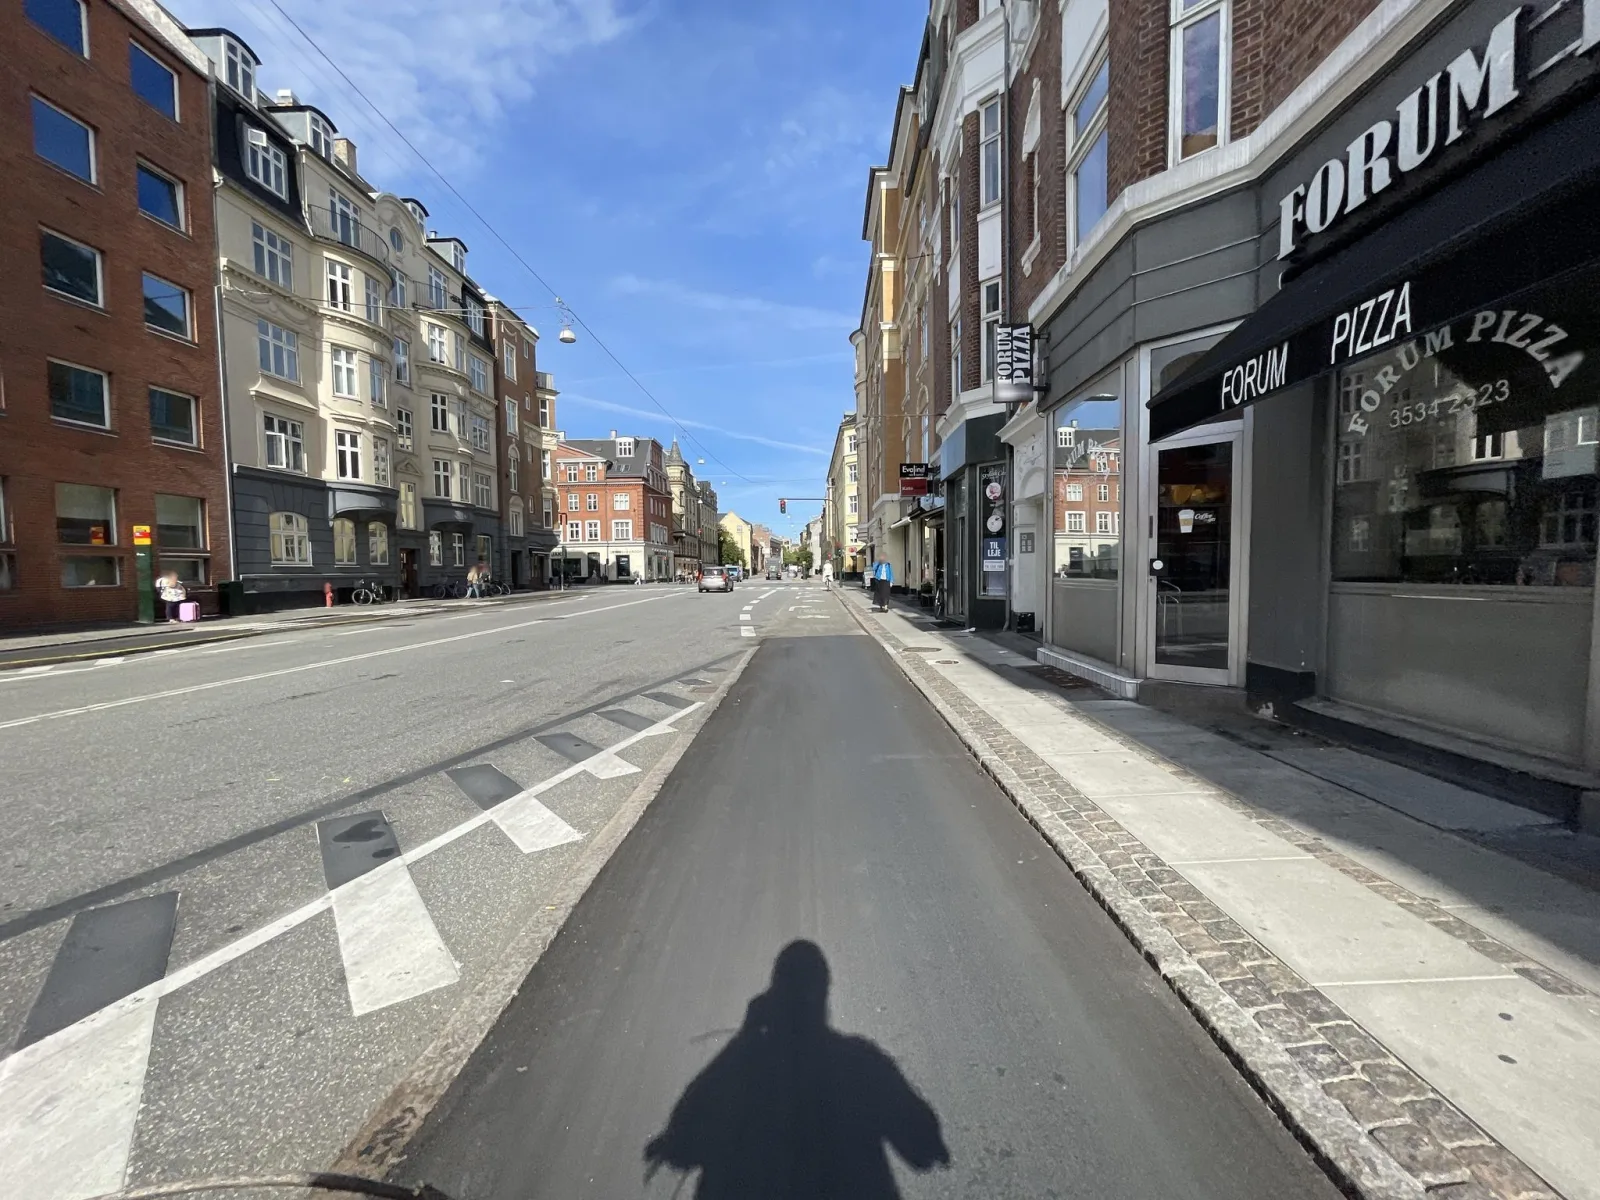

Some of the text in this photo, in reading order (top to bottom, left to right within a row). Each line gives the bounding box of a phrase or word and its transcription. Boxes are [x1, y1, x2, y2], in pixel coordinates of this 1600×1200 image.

[1277, 5, 1522, 260] FORUM
[997, 326, 1012, 384] FORUM
[1012, 325, 1031, 384] PIZZA
[1221, 281, 1411, 410] FORUM PIZZA
[1348, 310, 1585, 436] FORUM PIZZA
[1389, 400, 1440, 428] 3534
[987, 549, 1001, 557] LEJE
[989, 541, 999, 549] TIL
